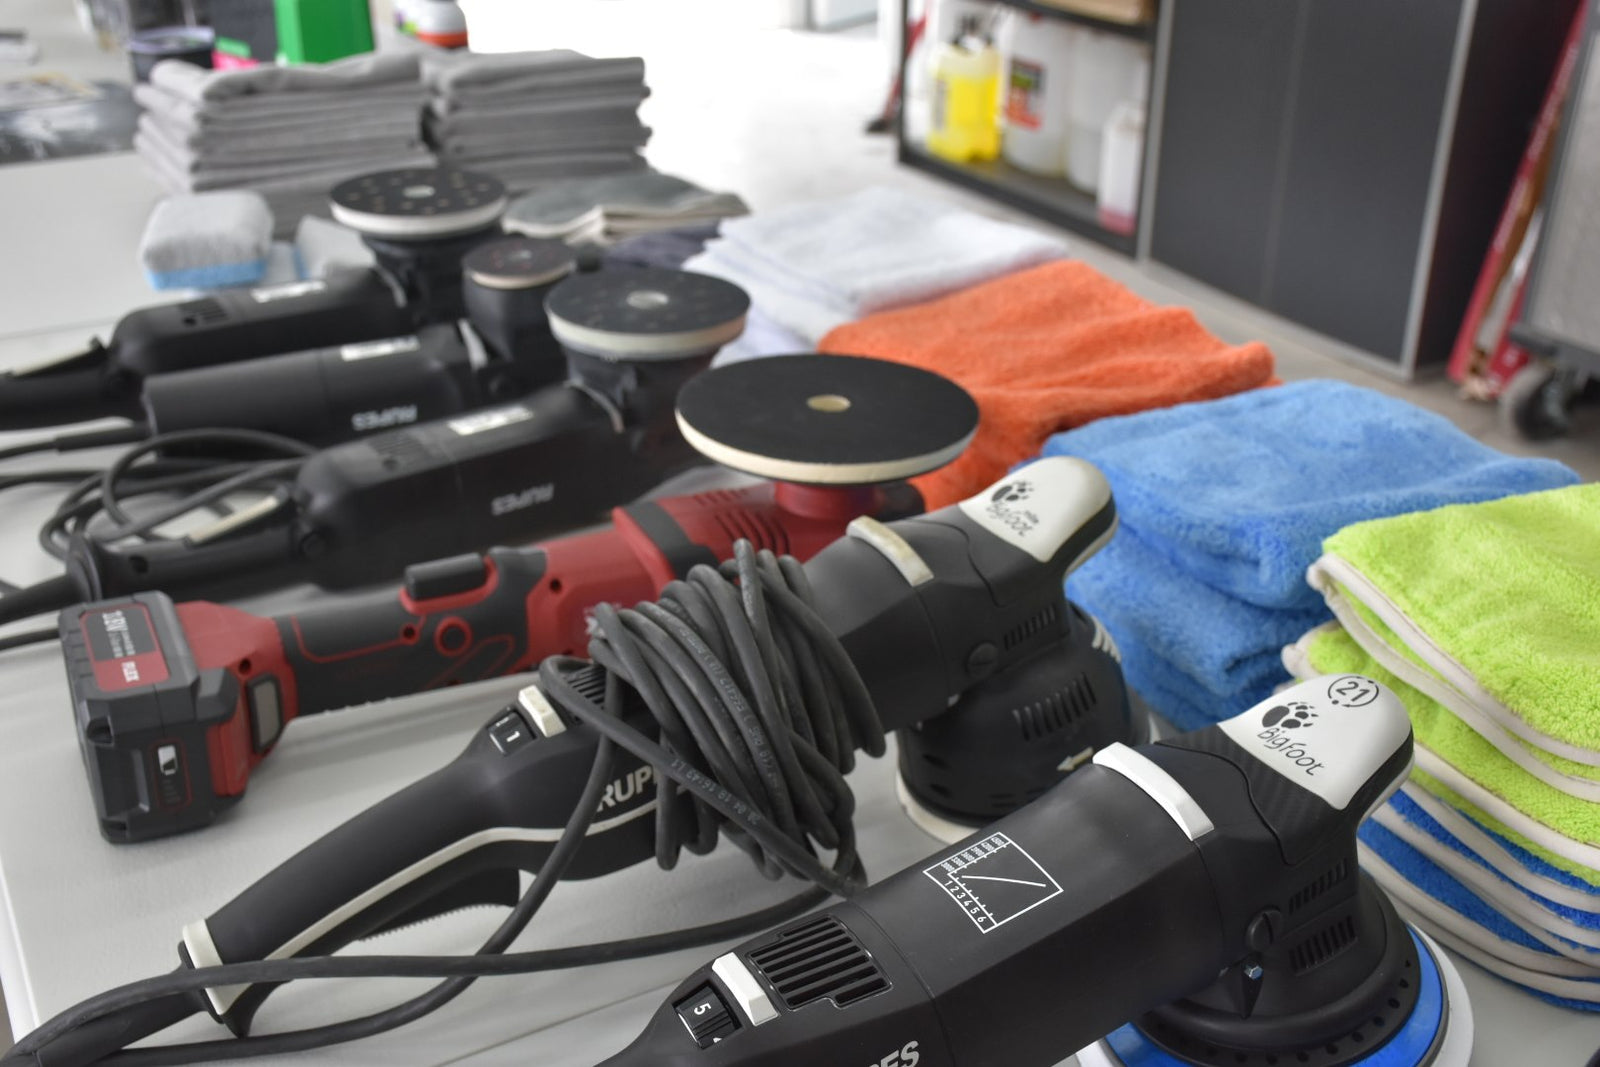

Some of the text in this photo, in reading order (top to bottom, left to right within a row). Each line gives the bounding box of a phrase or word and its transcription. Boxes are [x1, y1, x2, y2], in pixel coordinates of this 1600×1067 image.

[1336, 681, 1371, 702] 21
[963, 899, 973, 907] 4
[970, 906, 980, 915] 5
[694, 1002, 712, 1015] 5
